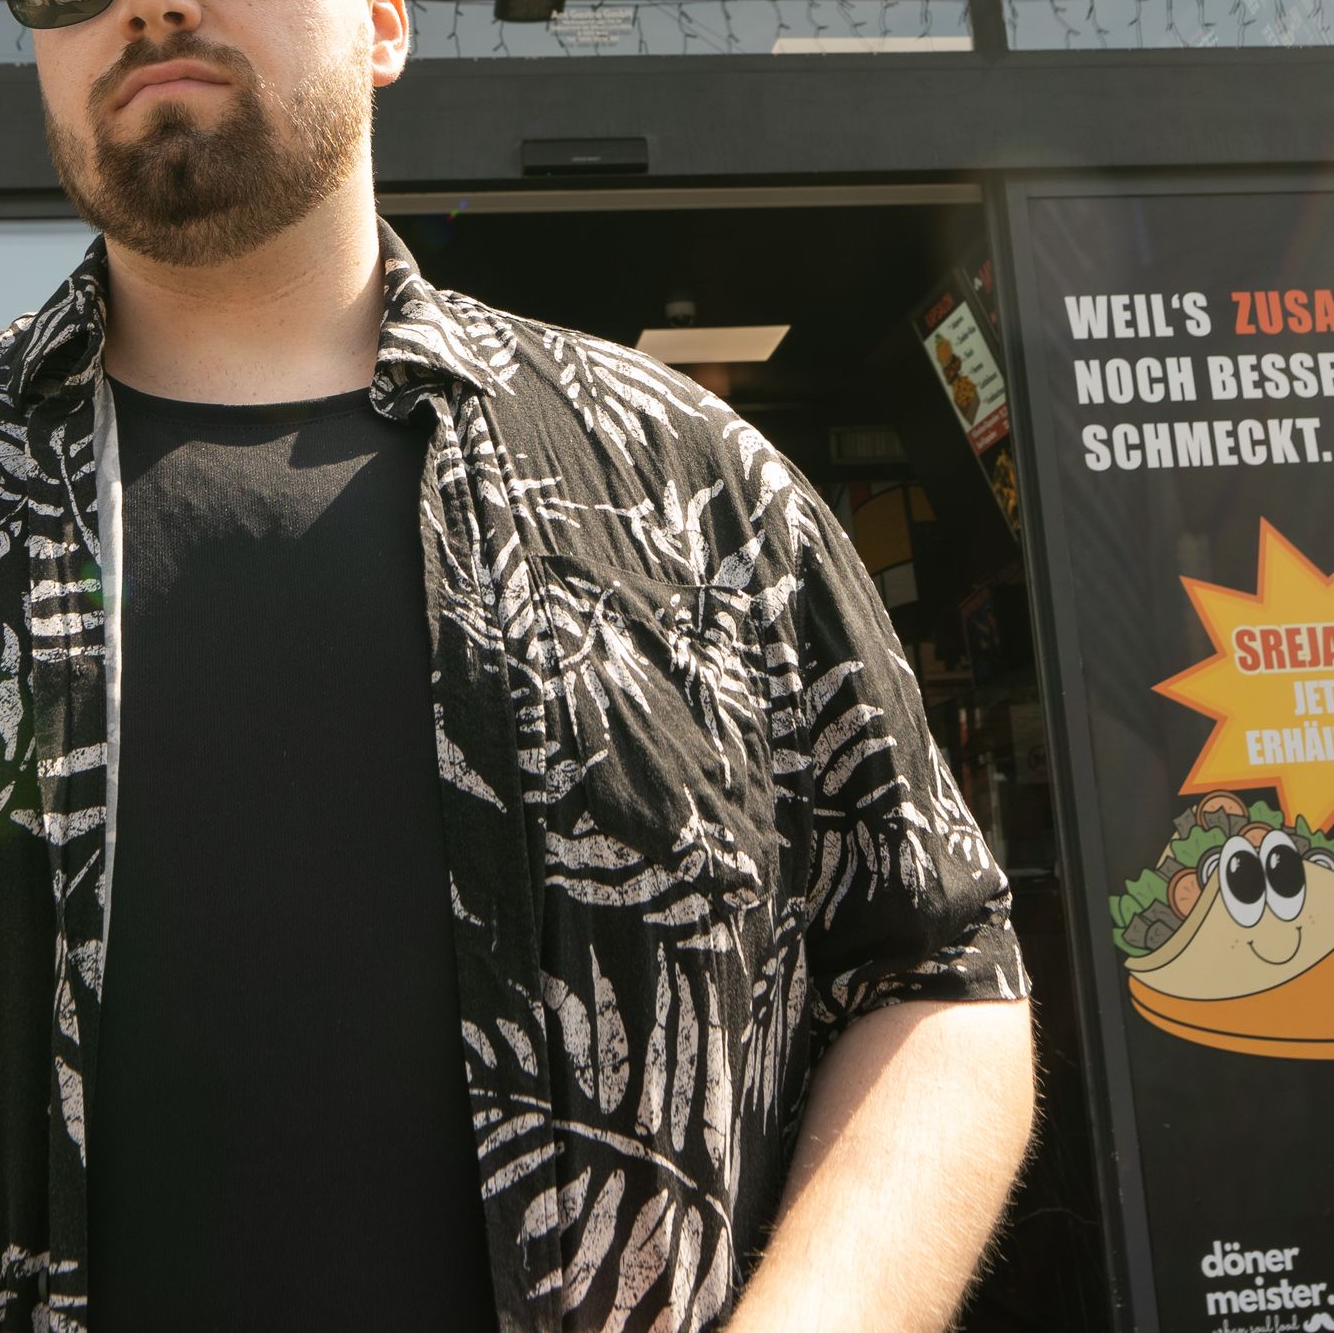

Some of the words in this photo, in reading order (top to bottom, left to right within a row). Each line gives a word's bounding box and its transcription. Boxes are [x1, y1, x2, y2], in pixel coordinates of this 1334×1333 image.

[1073, 356, 1197, 405] NOCH
[1081, 417, 1333, 471] SCHMECKT.
[1201, 1240, 1300, 1278] döner
